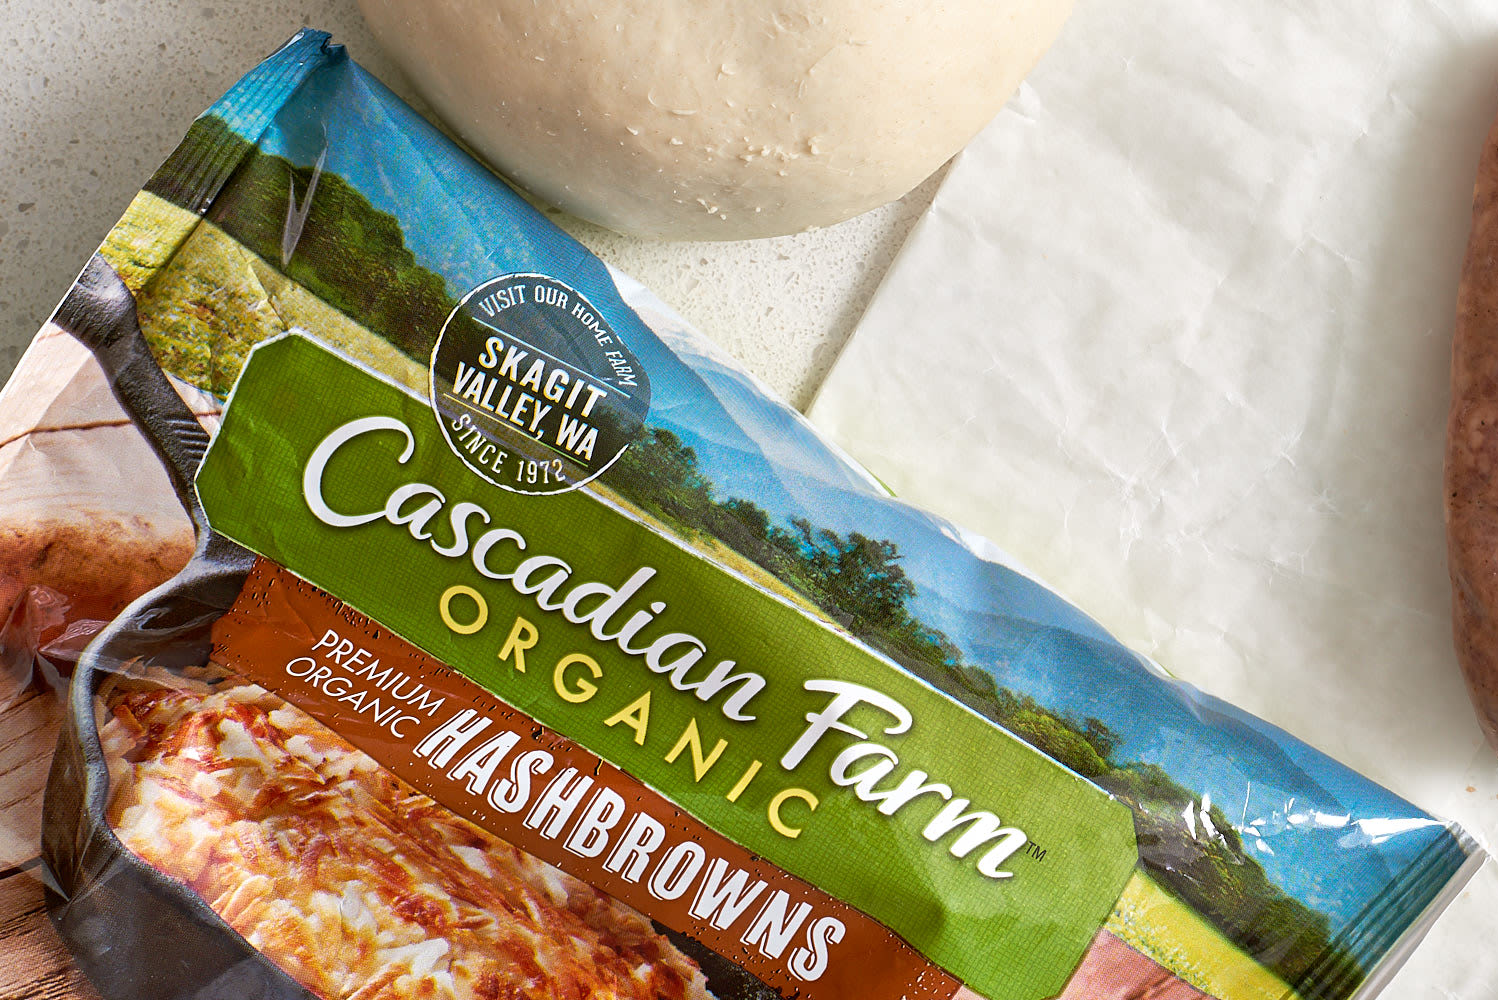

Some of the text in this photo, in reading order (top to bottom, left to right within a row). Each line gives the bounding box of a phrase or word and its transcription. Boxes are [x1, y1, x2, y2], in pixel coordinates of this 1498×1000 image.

[477, 335, 608, 419] SKAGIT
[478, 284, 639, 388] VISIT OUR HOME FARM
[451, 413, 568, 486] SINCE 1972
[452, 360, 600, 462] VALLEY, WA
[283, 655, 423, 742] ORGANIC
[301, 415, 767, 724] Cascadian
[779, 676, 1035, 880] Farm
[310, 628, 447, 719] PREMIUM
[437, 583, 820, 841] ORGANIC
[412, 707, 848, 984] HASHBROWNS
